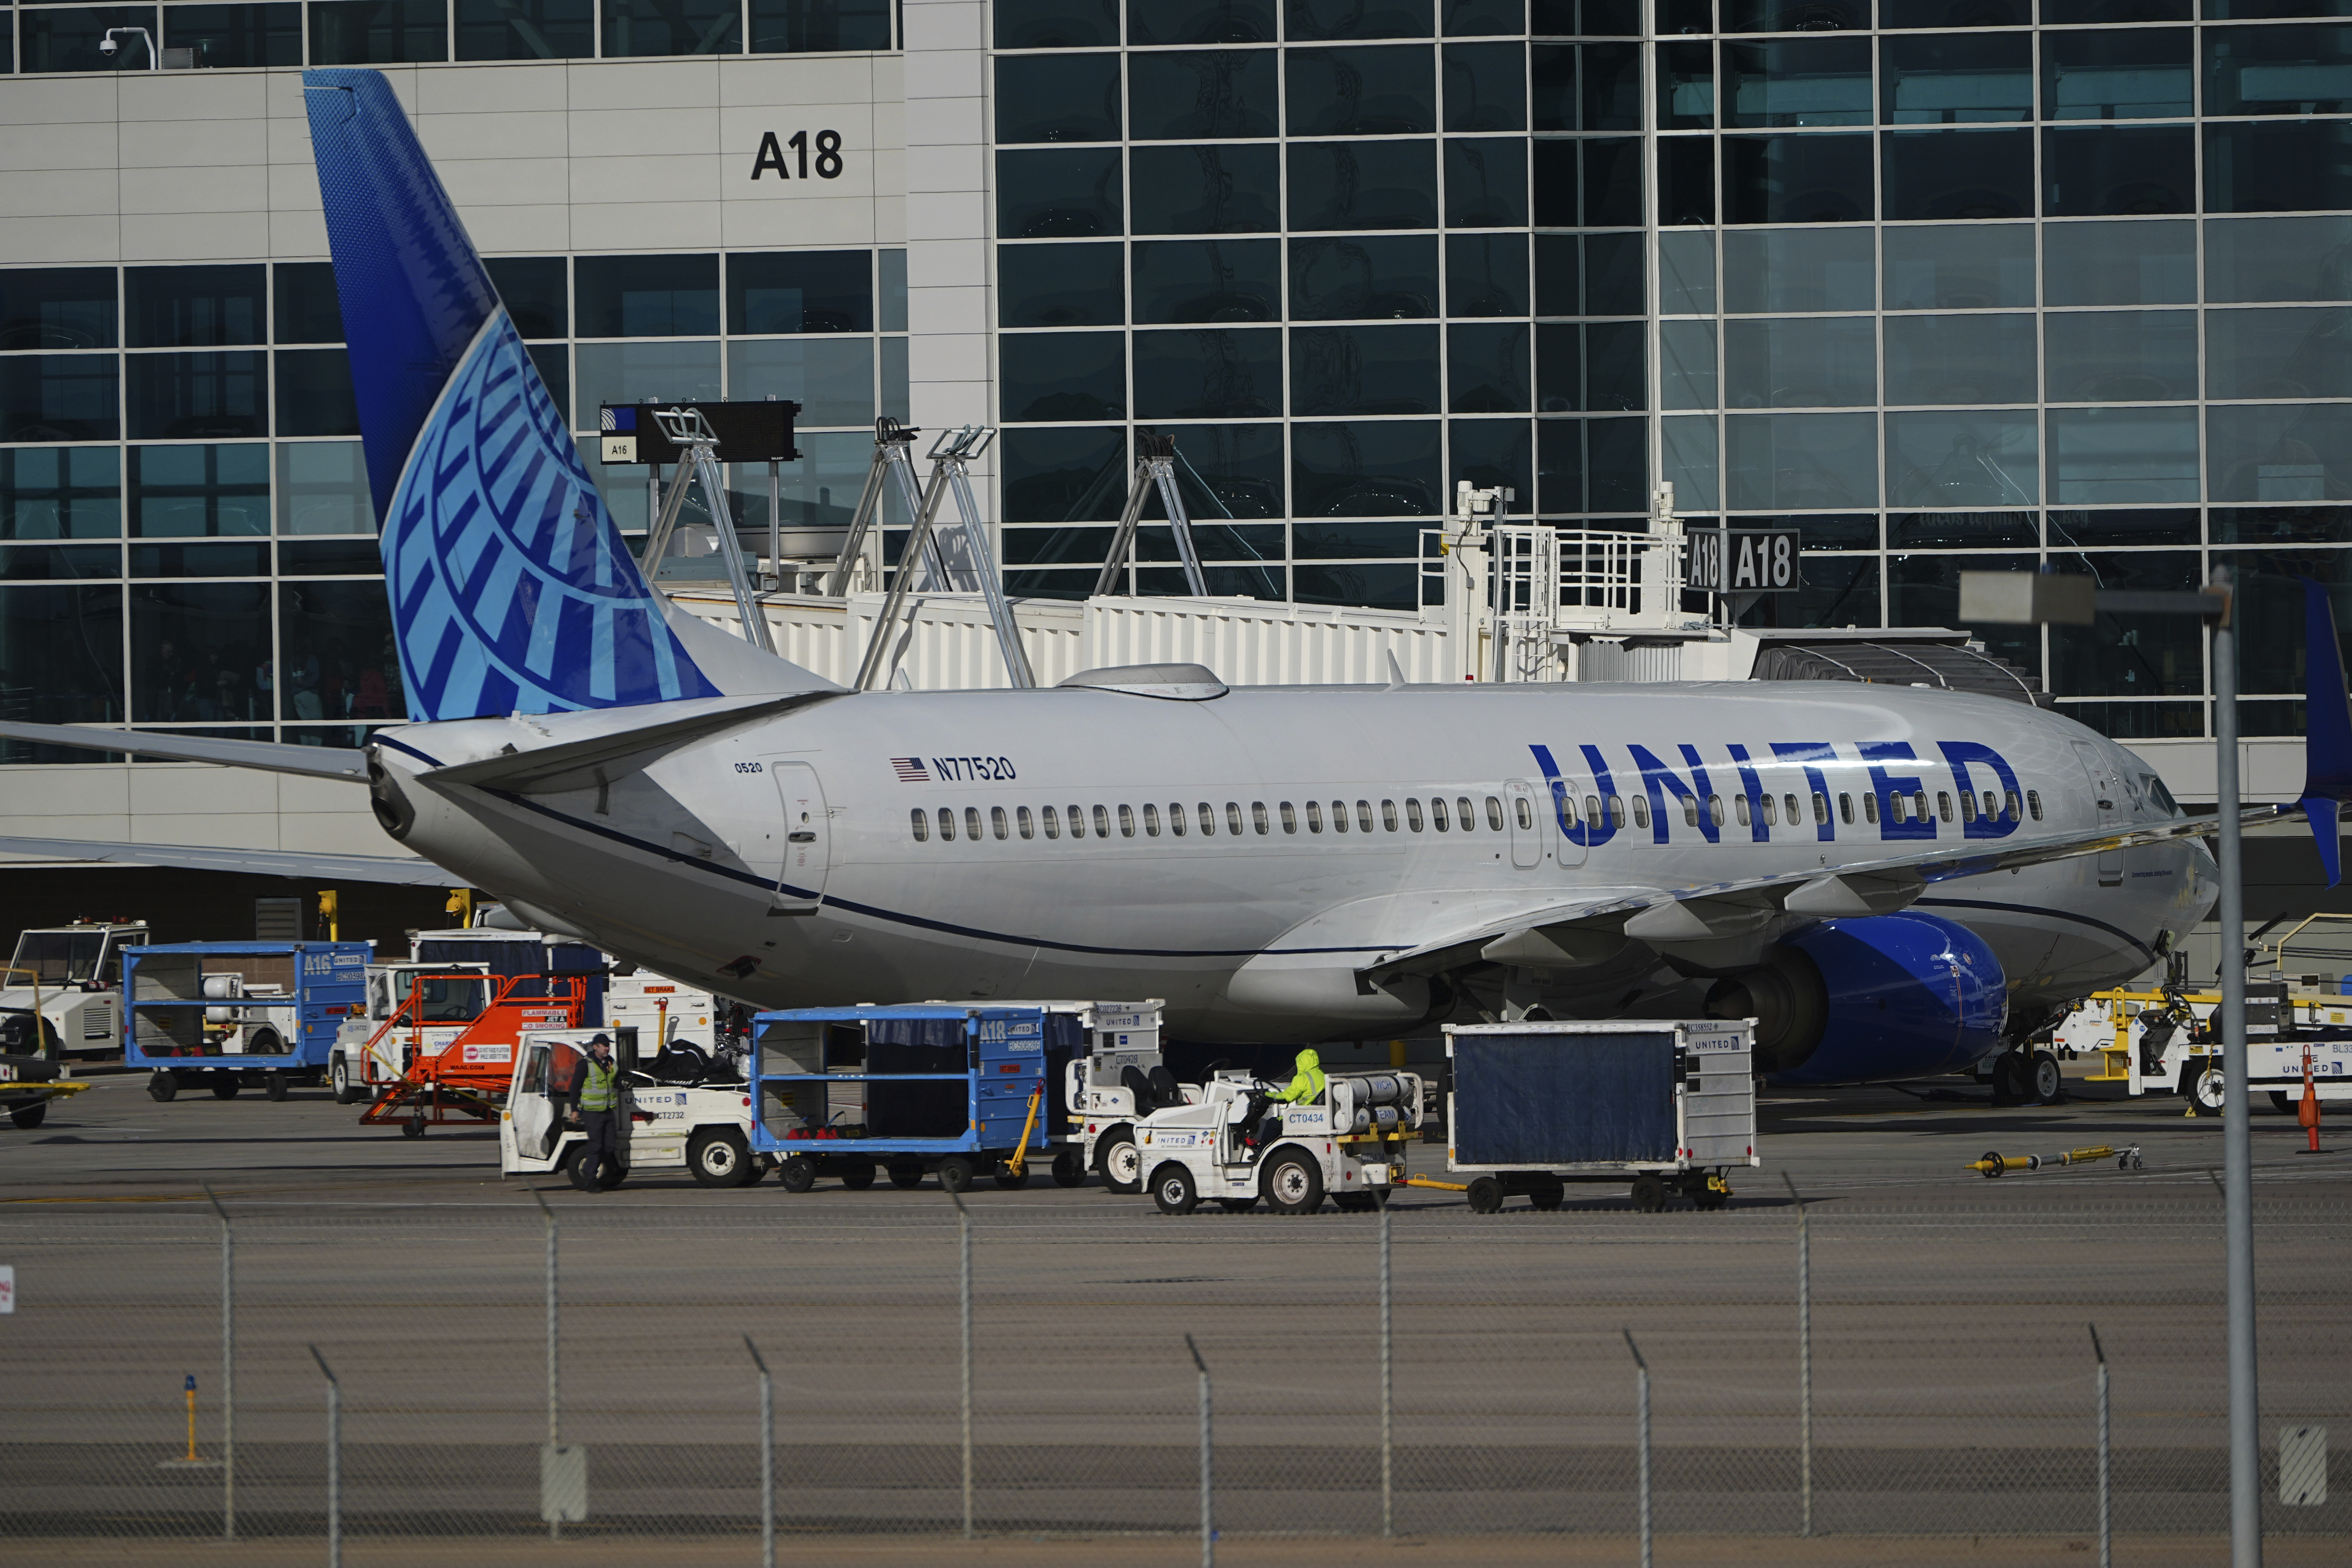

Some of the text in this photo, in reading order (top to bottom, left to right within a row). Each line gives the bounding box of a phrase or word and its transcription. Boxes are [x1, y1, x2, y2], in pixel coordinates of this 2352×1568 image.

[751, 130, 842, 180] A18
[612, 445, 626, 454] A16
[1691, 534, 1718, 587] A18
[1735, 535, 1790, 586] A18
[735, 762, 762, 773] 0520
[933, 757, 1016, 780] N77520
[1528, 741, 2022, 847] UNITED
[304, 955, 330, 975] A16
[1096, 1004, 1122, 1013] BC027236
[980, 1020, 1006, 1044] A18
[1686, 1023, 1712, 1032] CC358552
[1696, 1040, 1729, 1049] UNITED
[2283, 1065, 2328, 1073] UNIED
[1374, 1081, 1392, 1089] WCH
[1289, 1114, 1323, 1123] CT0434
[1361, 1153, 1385, 1163] CT0434
